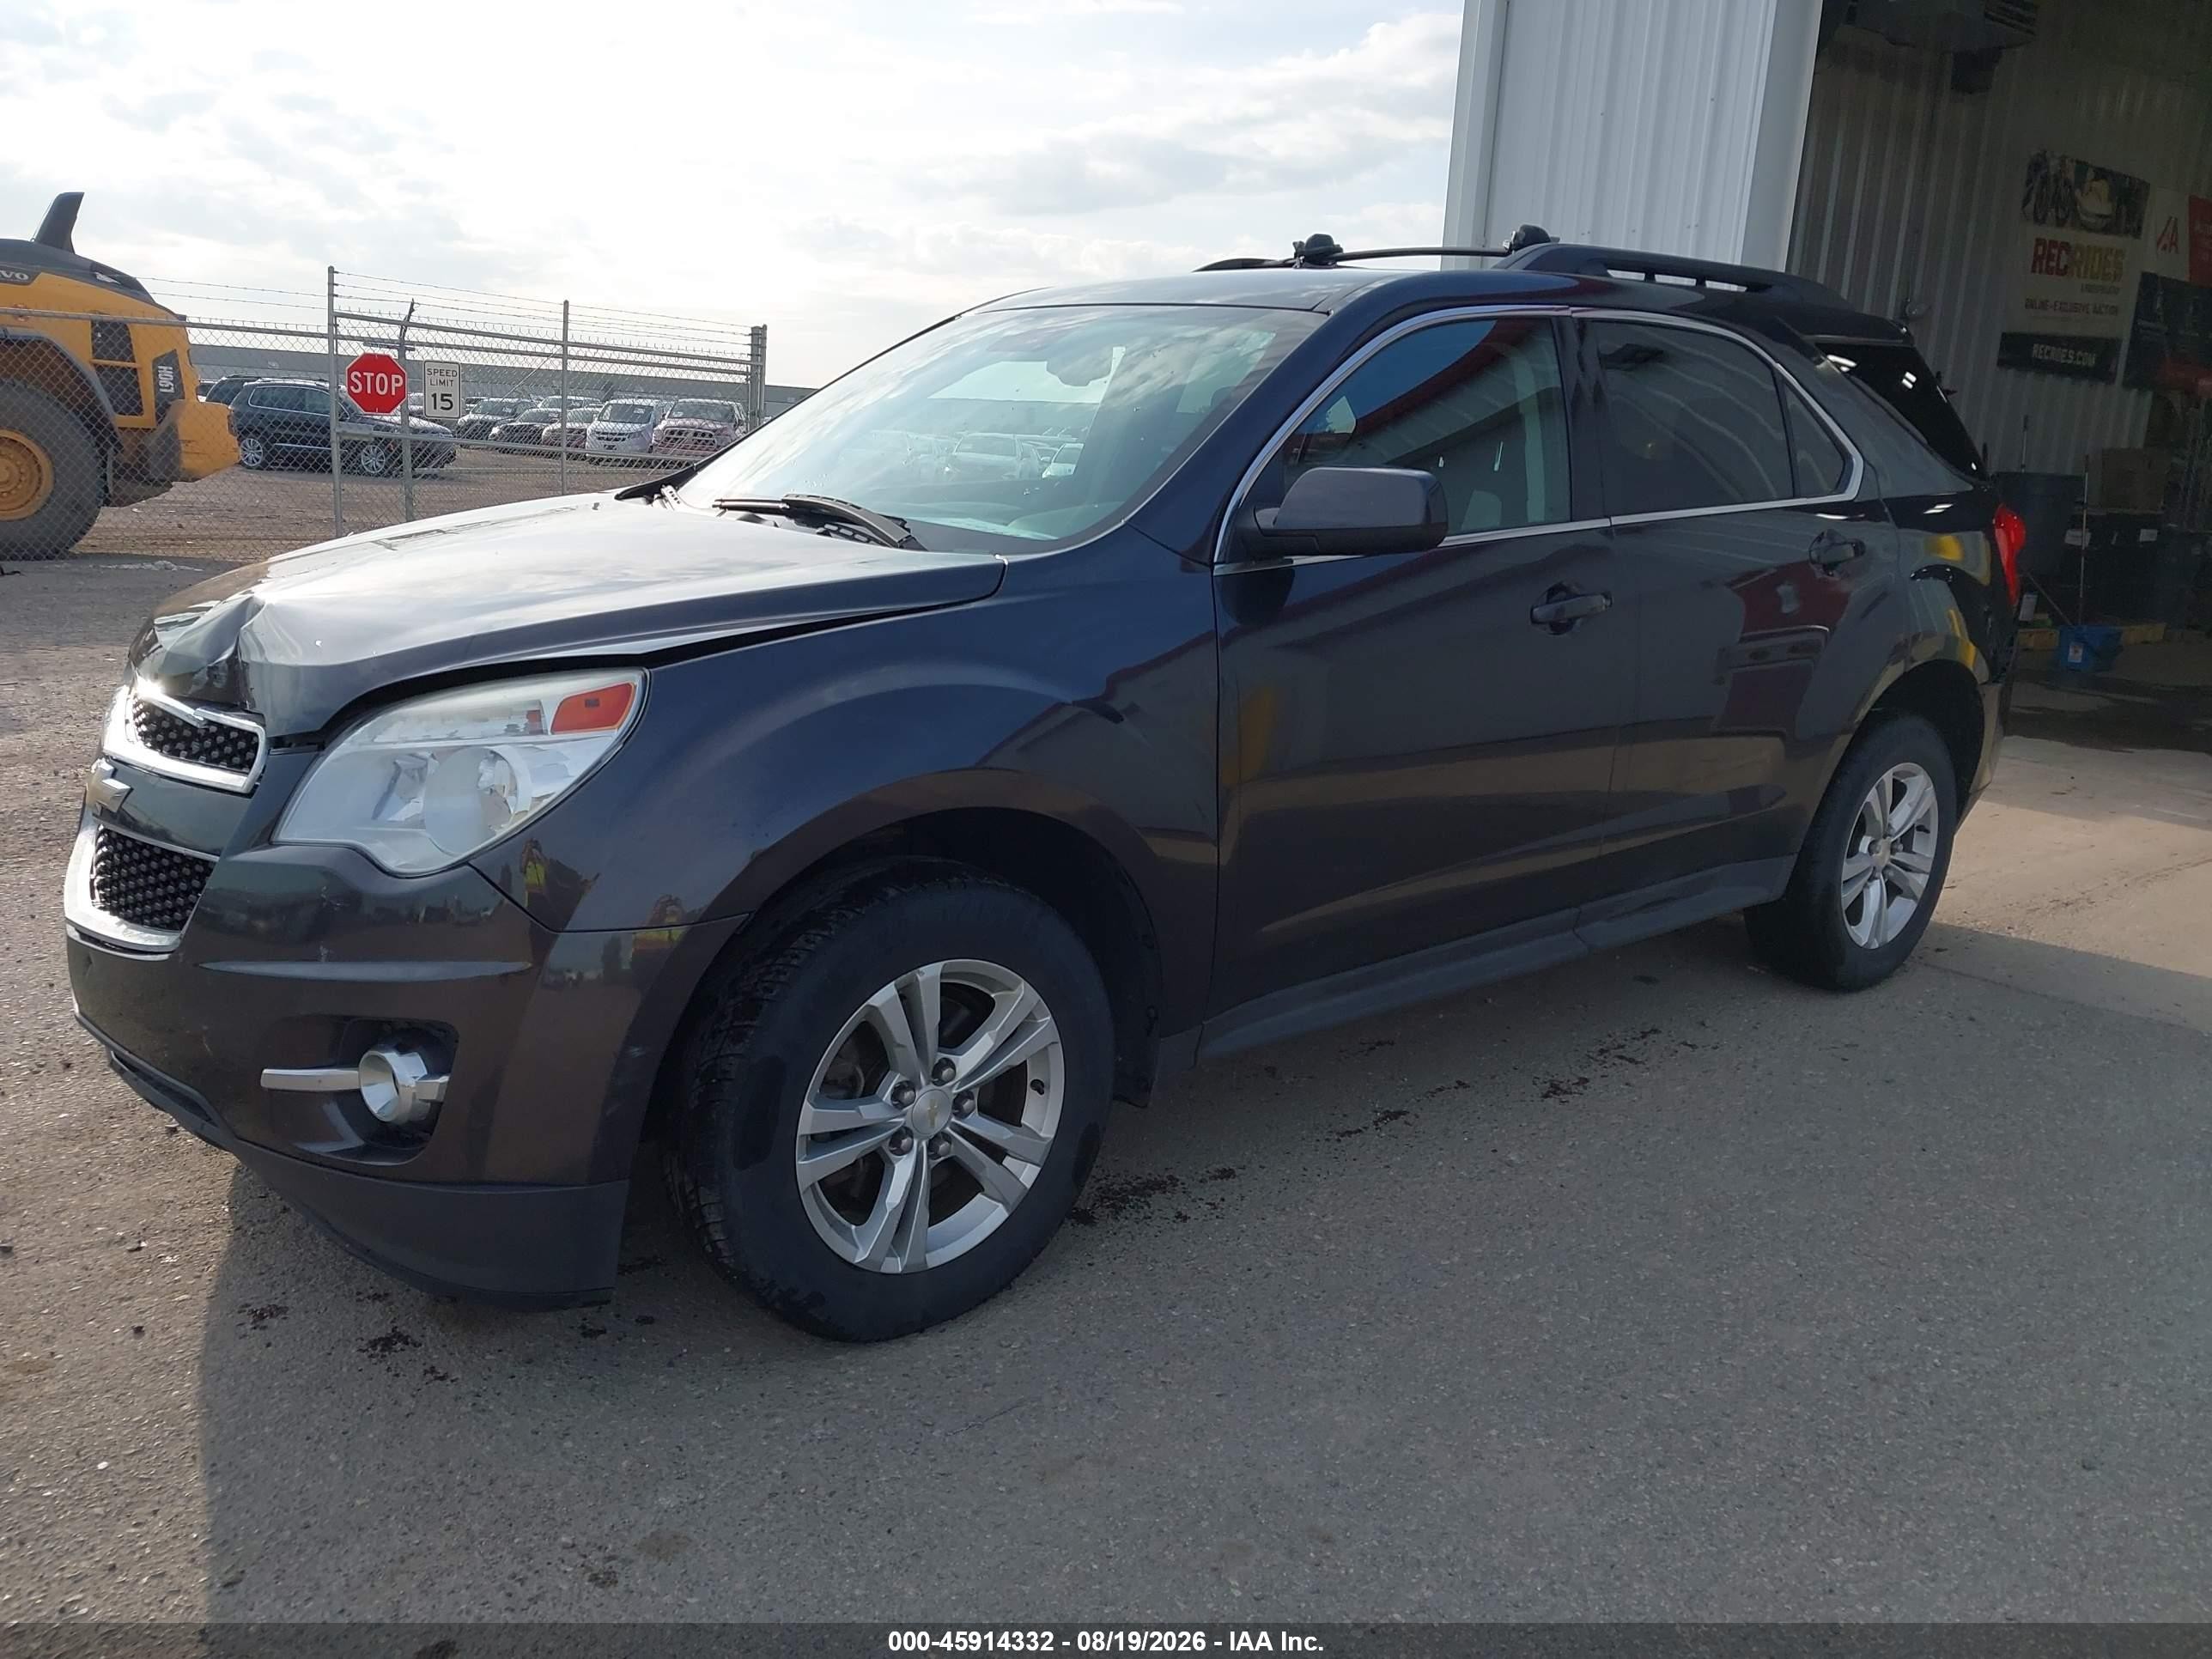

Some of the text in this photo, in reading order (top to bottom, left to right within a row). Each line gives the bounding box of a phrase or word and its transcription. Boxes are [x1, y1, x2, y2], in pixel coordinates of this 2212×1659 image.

[157, 365, 175, 393] L90H
[427, 368, 458, 378] SPEED
[429, 378, 454, 387] LIMIT
[350, 371, 404, 396] STOP
[431, 392, 454, 411] 15
